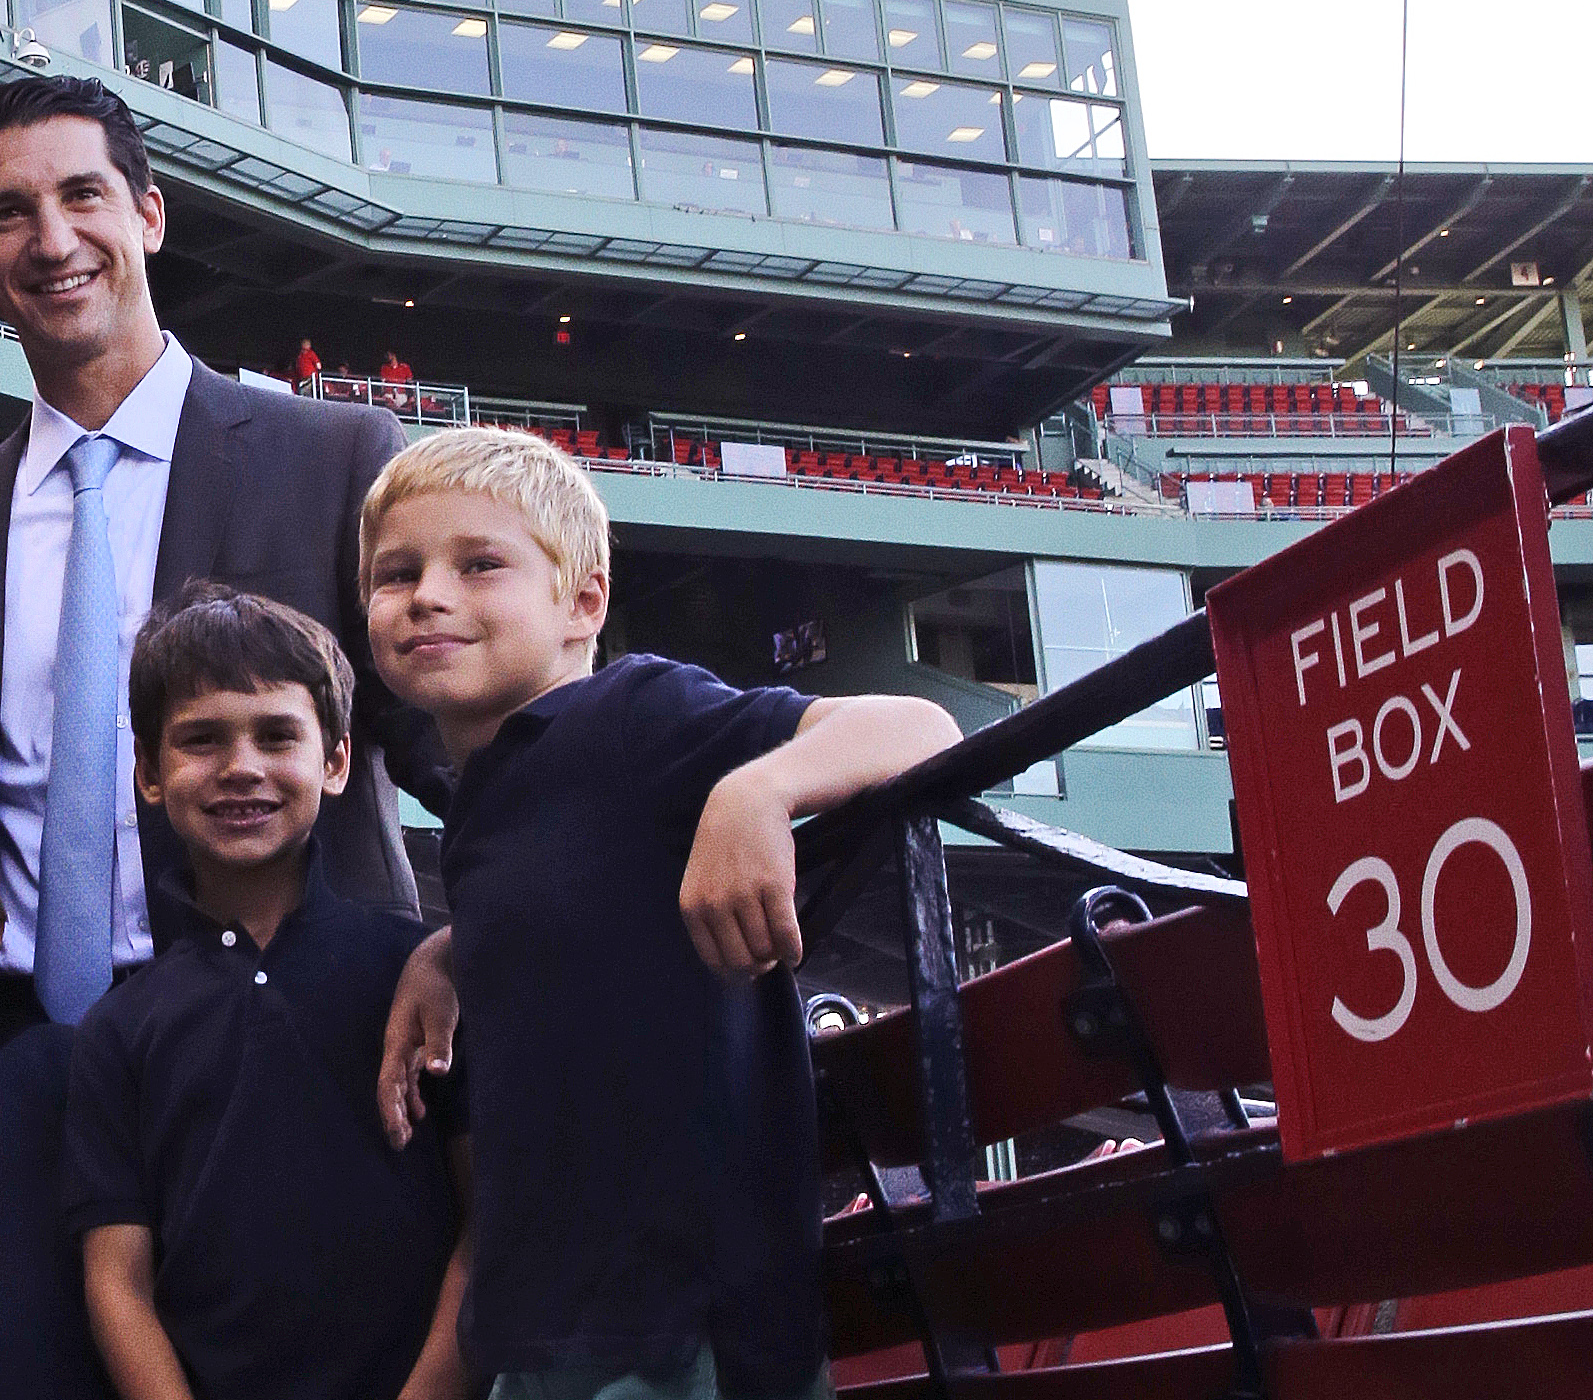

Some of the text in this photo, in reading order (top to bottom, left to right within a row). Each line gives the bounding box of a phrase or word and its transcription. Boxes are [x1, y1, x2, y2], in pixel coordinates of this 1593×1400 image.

[1290, 548, 1485, 706] FIELD
[1327, 668, 1471, 803] BOX
[1327, 816, 1532, 1042] 30
